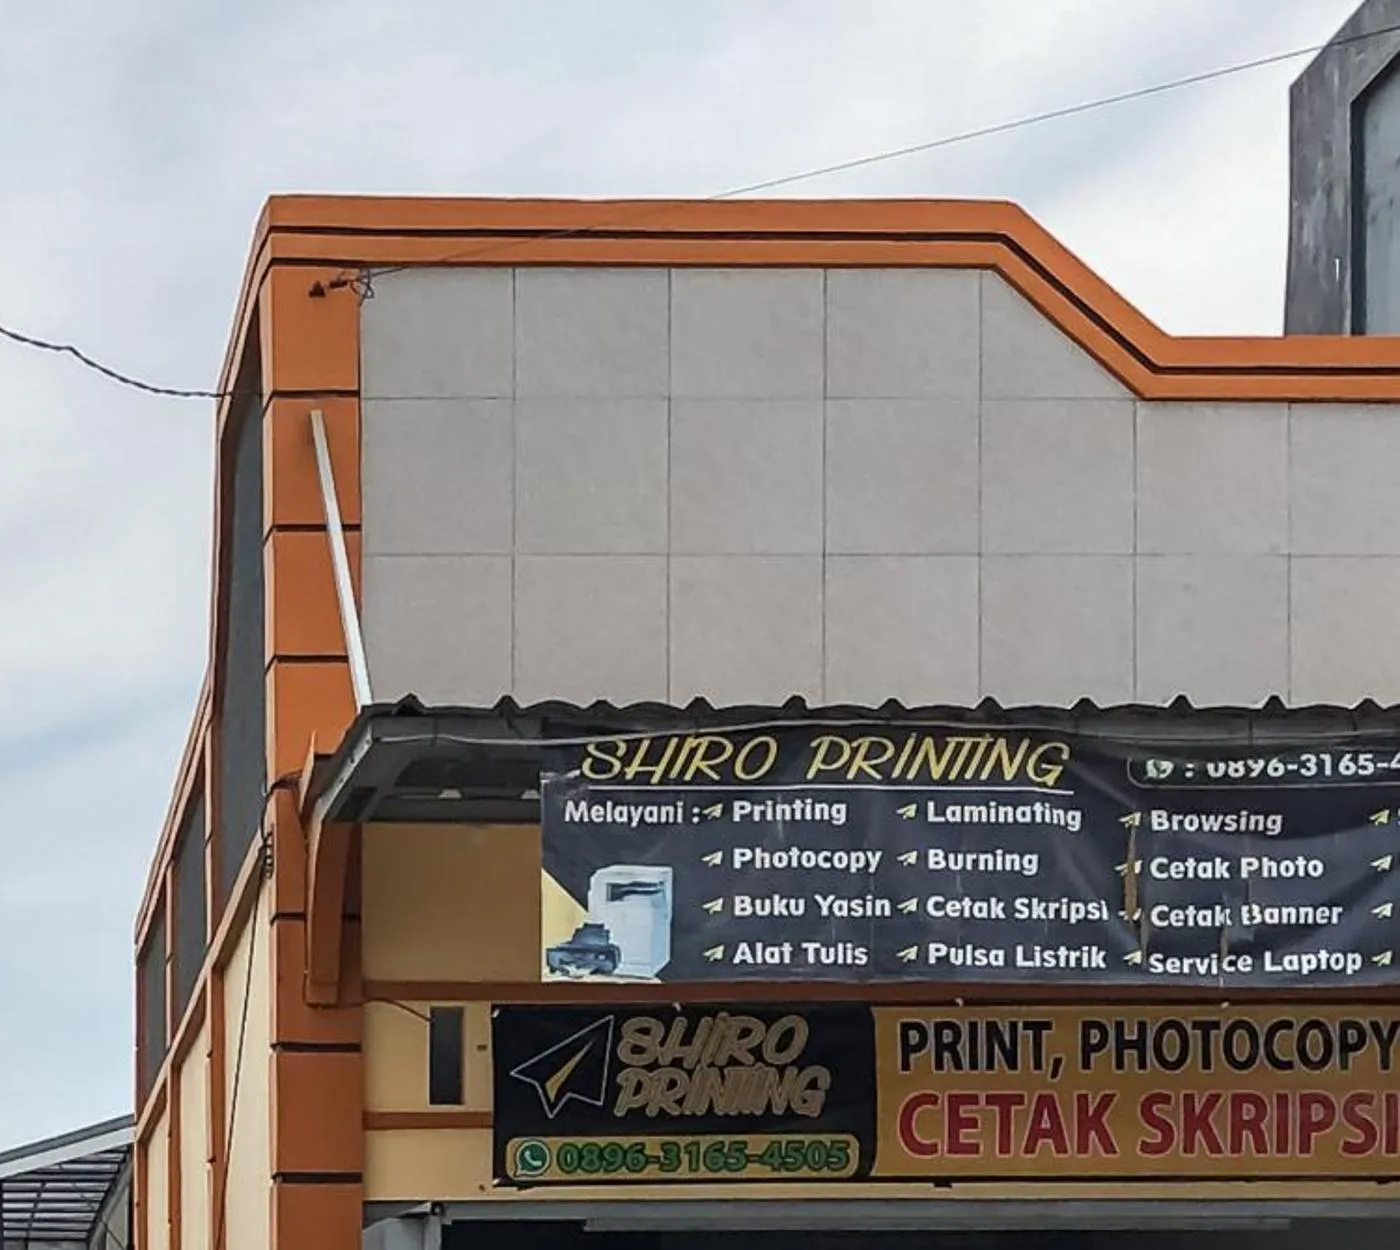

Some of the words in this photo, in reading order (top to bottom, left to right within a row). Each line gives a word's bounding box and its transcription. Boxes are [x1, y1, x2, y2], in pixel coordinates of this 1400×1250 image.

[580, 735, 779, 784] SHIRO
[806, 733, 1071, 787] PRINTING
[564, 801, 684, 828] Melayani
[732, 800, 848, 826] Printing
[927, 801, 1083, 831] Laminating
[1150, 809, 1283, 836] Browsing
[733, 846, 883, 874] Photocopy
[928, 849, 1040, 876] Burning
[1149, 858, 1231, 880] Cetak
[1241, 856, 1325, 880] Photo
[734, 895, 806, 918] Buku
[815, 894, 892, 918] Yasin
[926, 896, 1006, 919] Cetak
[1014, 898, 1110, 924] Skripsi
[1150, 904, 1231, 928] Cetak
[1242, 903, 1343, 926] Banner
[733, 942, 791, 966] Alat
[802, 942, 869, 966] Tulis
[928, 944, 1005, 968] Pulsa
[1016, 946, 1107, 969] Listrik
[1149, 952, 1253, 976] Service
[1264, 949, 1363, 975] Laptop
[616, 1012, 810, 1067] SHIRO
[899, 1019, 1065, 1081] PRINT,
[1080, 1018, 1400, 1074] PHOTOCOPY
[613, 1064, 833, 1117] PRINTING
[897, 1091, 1120, 1157] CETAK
[1137, 1090, 1400, 1157] SKRIPSI
[556, 1140, 850, 1174] 0896-3165-4505
